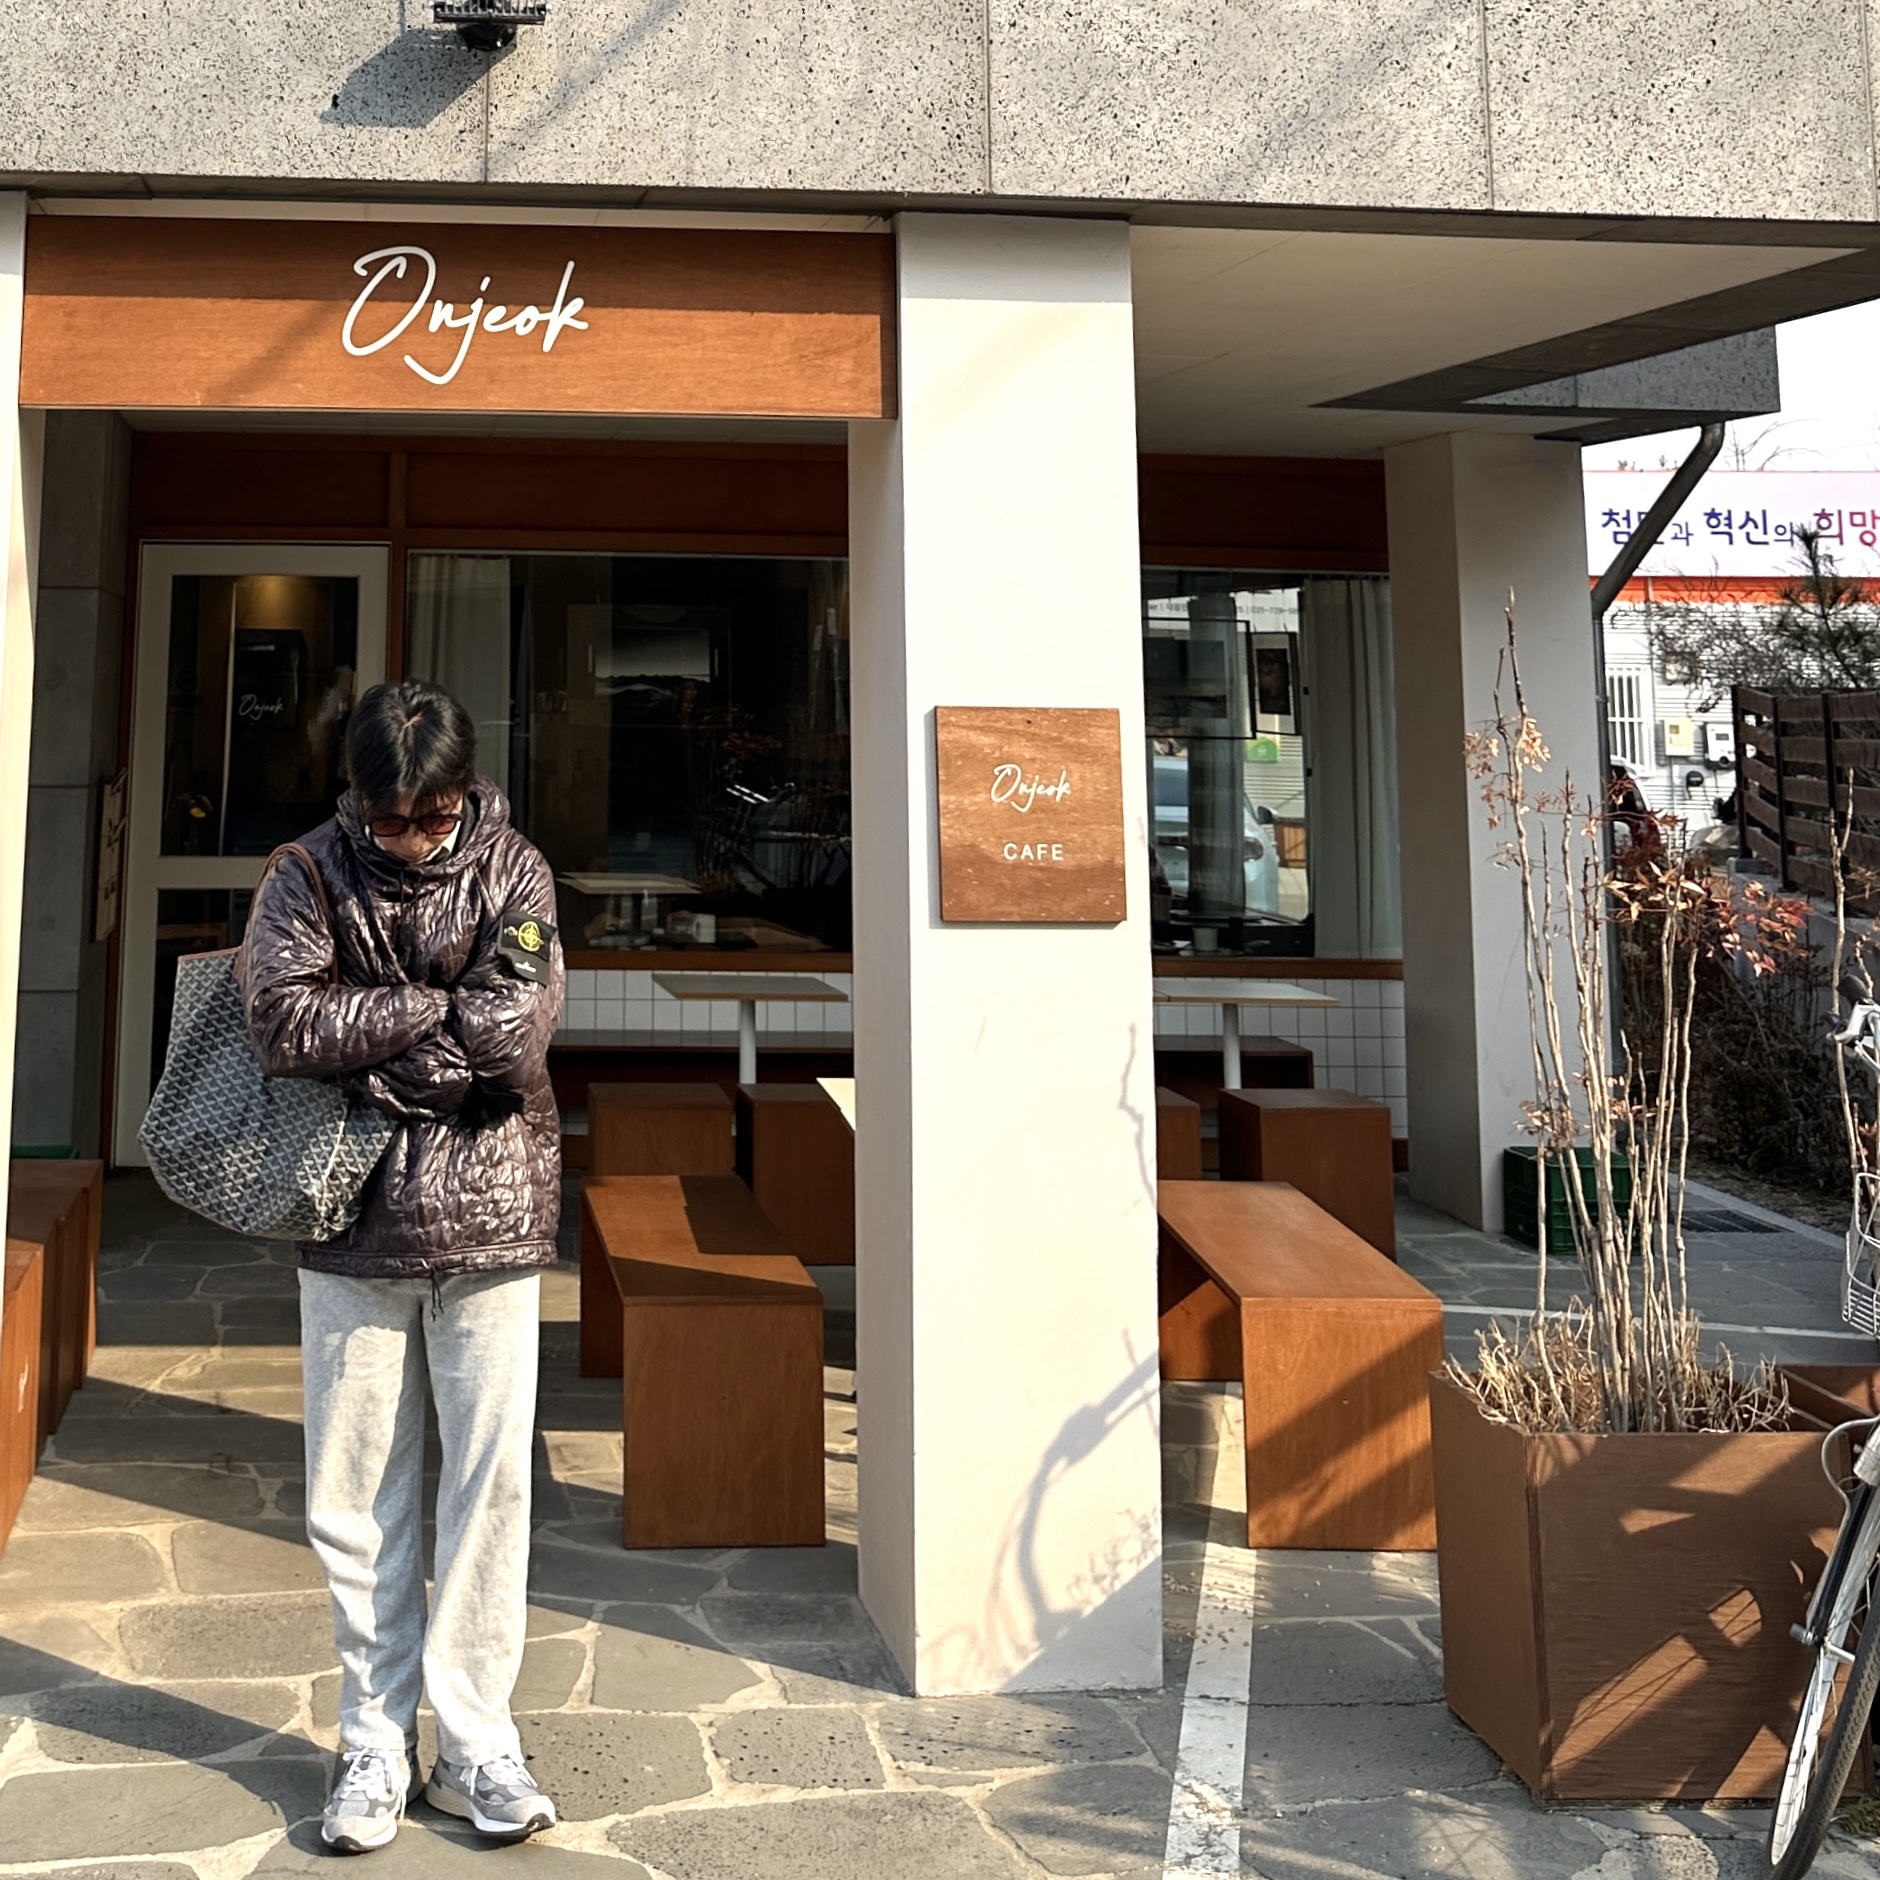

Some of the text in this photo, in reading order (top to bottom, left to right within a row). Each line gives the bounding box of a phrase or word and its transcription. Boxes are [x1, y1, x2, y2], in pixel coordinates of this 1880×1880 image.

[341, 245, 589, 385] Onjeok
[1703, 508, 1794, 547] 혁신의
[1813, 508, 1880, 547] 희망
[990, 763, 1071, 812] Onjeok
[1003, 843, 1064, 860] CAFE
